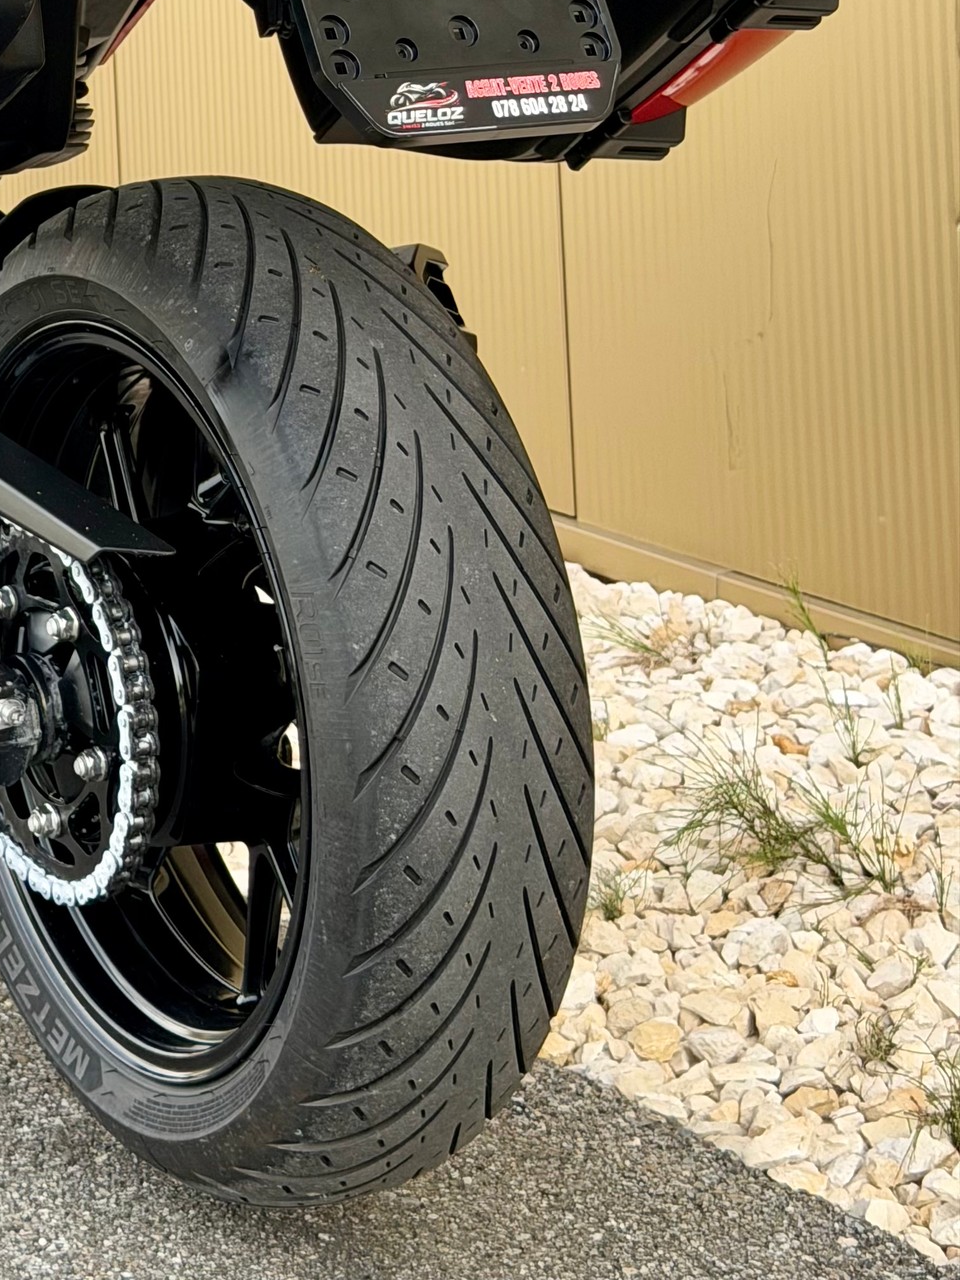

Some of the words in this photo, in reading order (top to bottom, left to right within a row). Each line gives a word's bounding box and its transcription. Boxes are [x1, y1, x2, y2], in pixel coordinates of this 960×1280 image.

[465, 75, 549, 98] ACHAT-VENTE
[548, 74, 560, 91] 2
[559, 71, 601, 91] ROUES
[387, 106, 464, 125] QUELOZ
[491, 99, 520, 118] 078
[520, 96, 549, 116] 604
[548, 95, 568, 114] 28
[568, 93, 588, 112] 24
